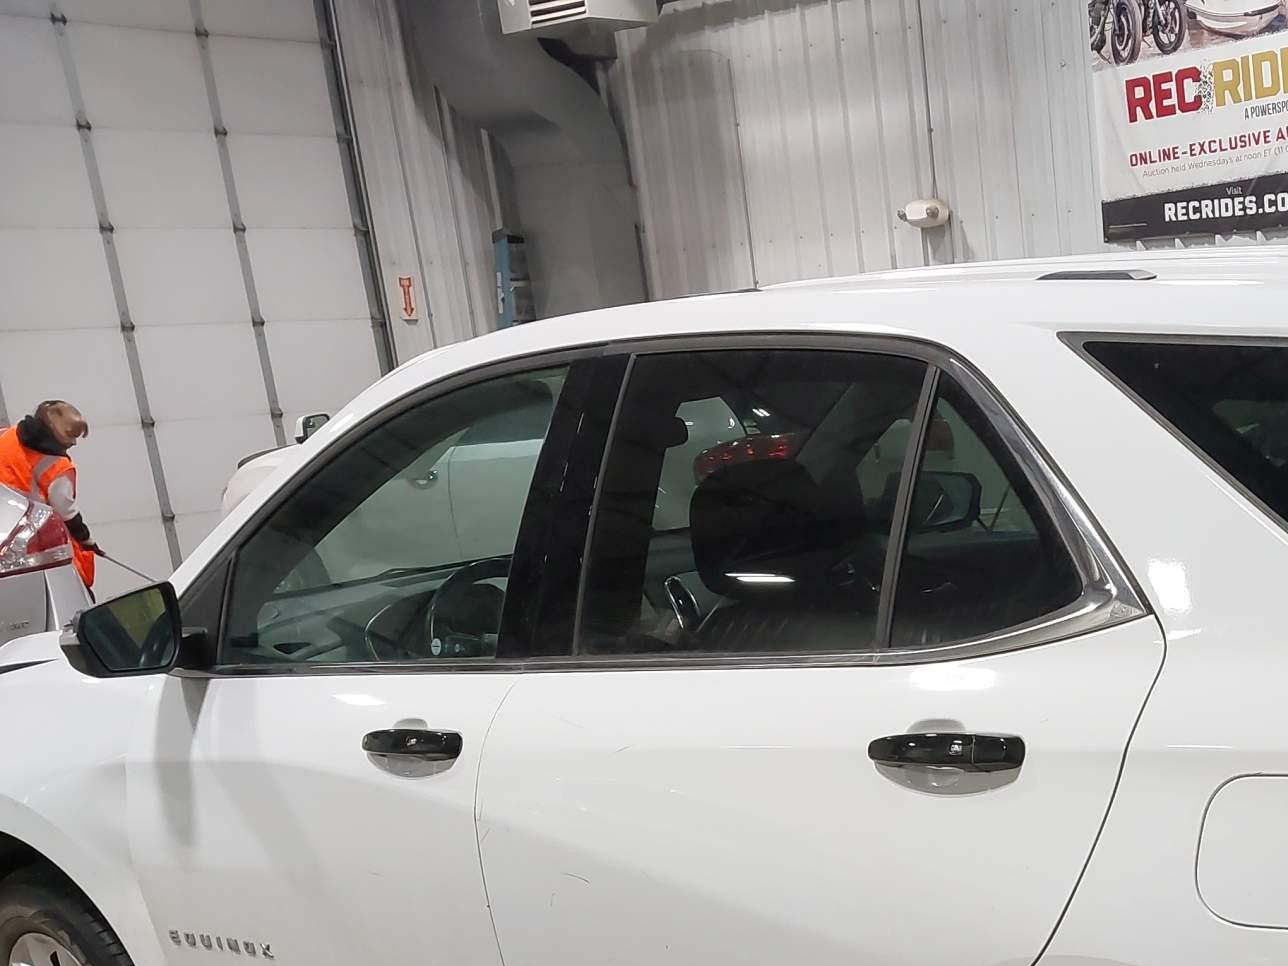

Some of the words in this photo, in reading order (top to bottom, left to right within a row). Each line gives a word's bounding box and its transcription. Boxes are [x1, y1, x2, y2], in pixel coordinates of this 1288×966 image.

[1125, 66, 1203, 123] REC
[1244, 107, 1250, 120] A
[1129, 130, 1271, 167] ONLINE-EXCLUSIVE
[1142, 167, 1169, 178] Auction
[1171, 163, 1186, 173] held
[1188, 157, 1232, 169] Wednesdays
[1244, 152, 1261, 160] noon
[1263, 148, 1272, 157] ET
[1226, 186, 1242, 195] Visit
[169, 929, 275, 960] EQUINOX
